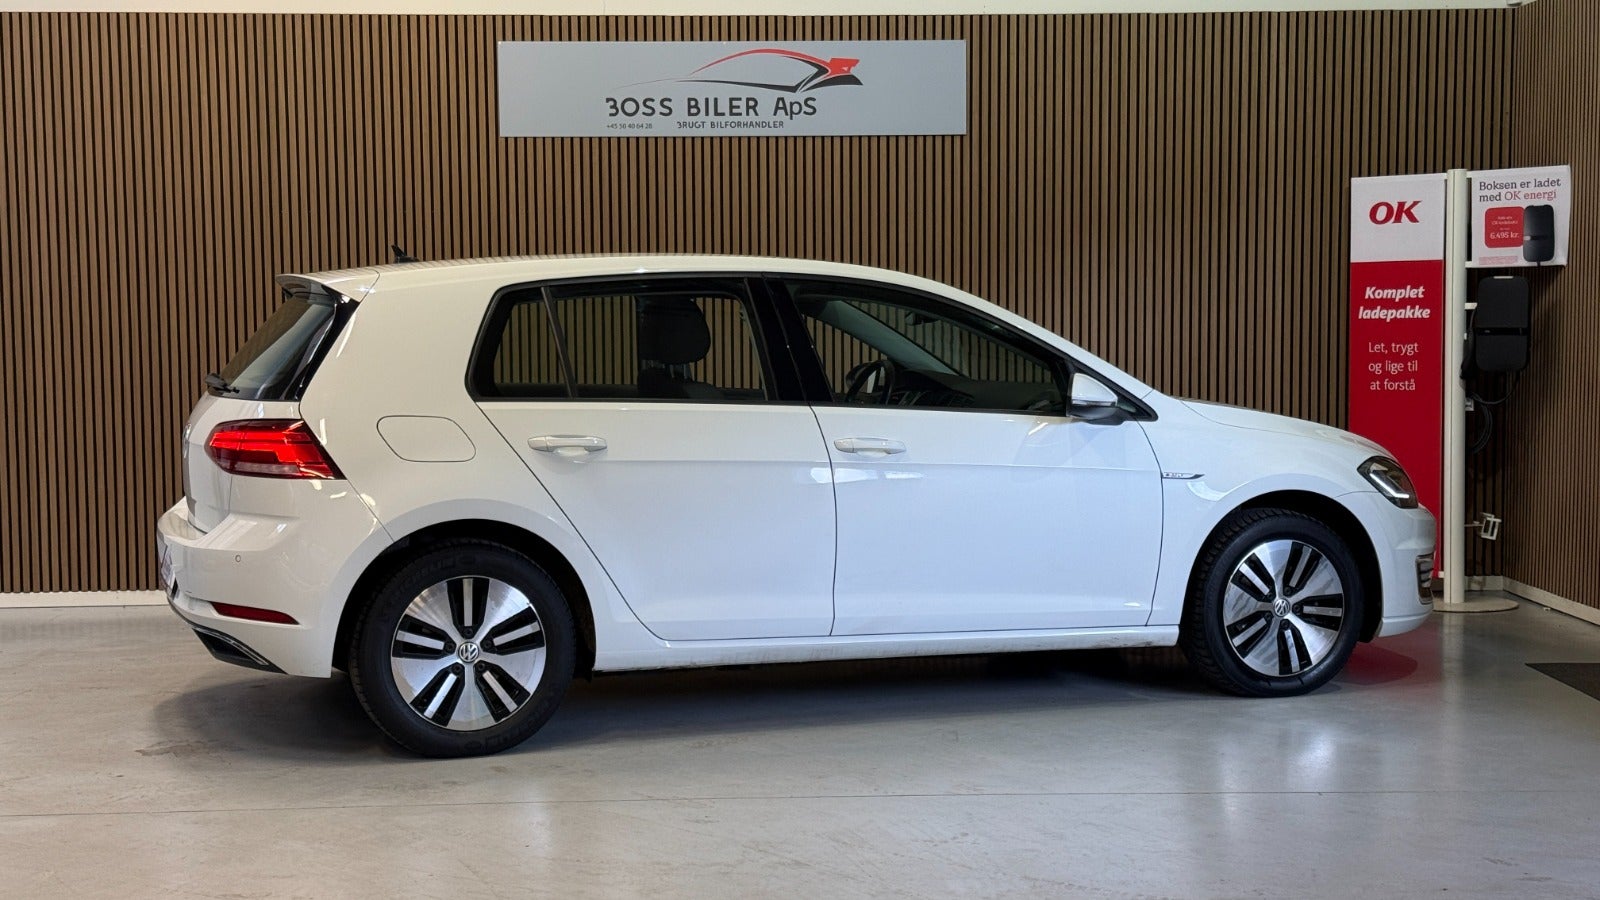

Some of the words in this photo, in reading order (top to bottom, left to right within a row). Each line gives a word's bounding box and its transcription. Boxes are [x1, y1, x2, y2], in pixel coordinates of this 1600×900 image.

[686, 97, 760, 117] BILER
[772, 96, 818, 120] ApS
[710, 120, 784, 129] BILFORHANDLER
[1479, 181, 1517, 191] Boksen
[1520, 180, 1532, 189] er
[1534, 178, 1561, 188] ladet
[1479, 192, 1502, 202] med
[1504, 191, 1522, 200] OK
[1524, 189, 1557, 201] energi
[1369, 200, 1422, 225] OK
[1365, 285, 1425, 302] Komplet
[1358, 305, 1431, 322] ladepakke
[1368, 342, 1388, 354] Let,
[1391, 342, 1419, 356] trygt
[1368, 363, 1382, 375] og
[1385, 361, 1405, 375] lige
[1407, 360, 1418, 372] til
[1370, 381, 1381, 391] at
[1384, 379, 1416, 391] forstå
